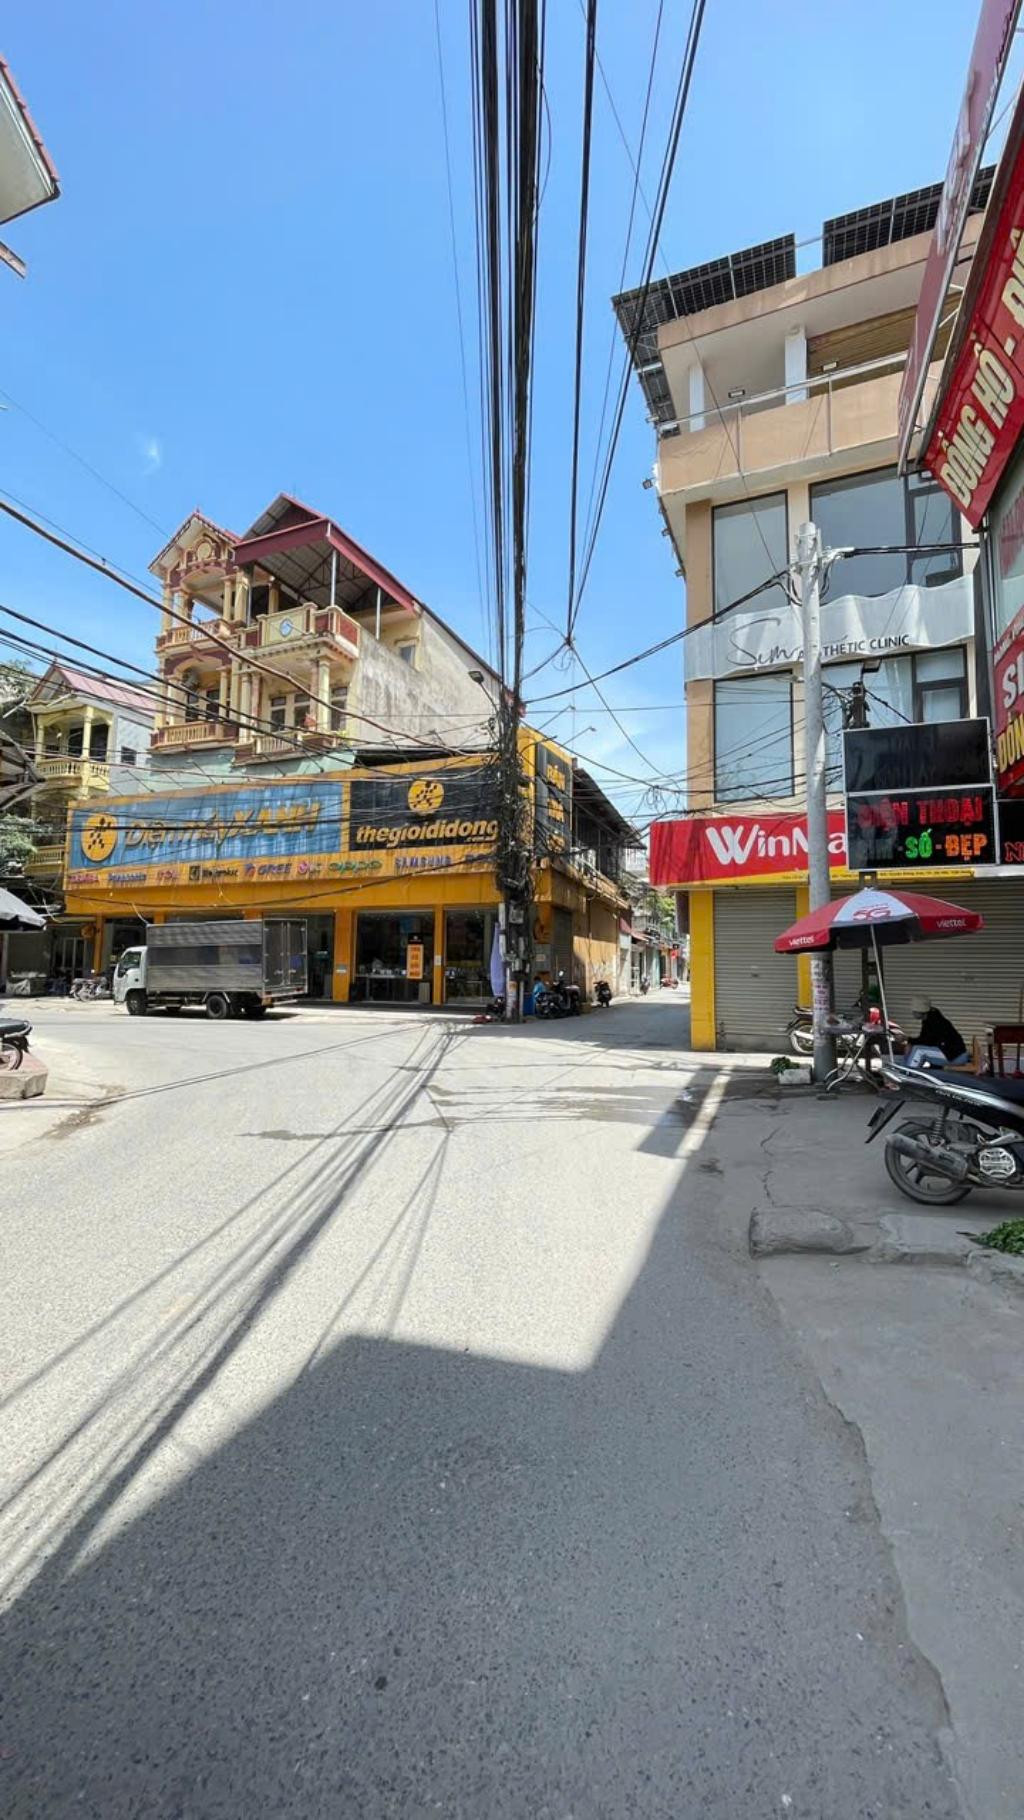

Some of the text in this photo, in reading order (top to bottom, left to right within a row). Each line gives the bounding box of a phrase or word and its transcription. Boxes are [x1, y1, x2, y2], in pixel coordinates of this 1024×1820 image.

[870, 635, 910, 650] CLINIC
[916, 795, 983, 827] THOẠI
[356, 818, 498, 849] thegioididong
[905, 828, 933, 858] SỐ
[945, 833, 988, 861] ĐẸP
